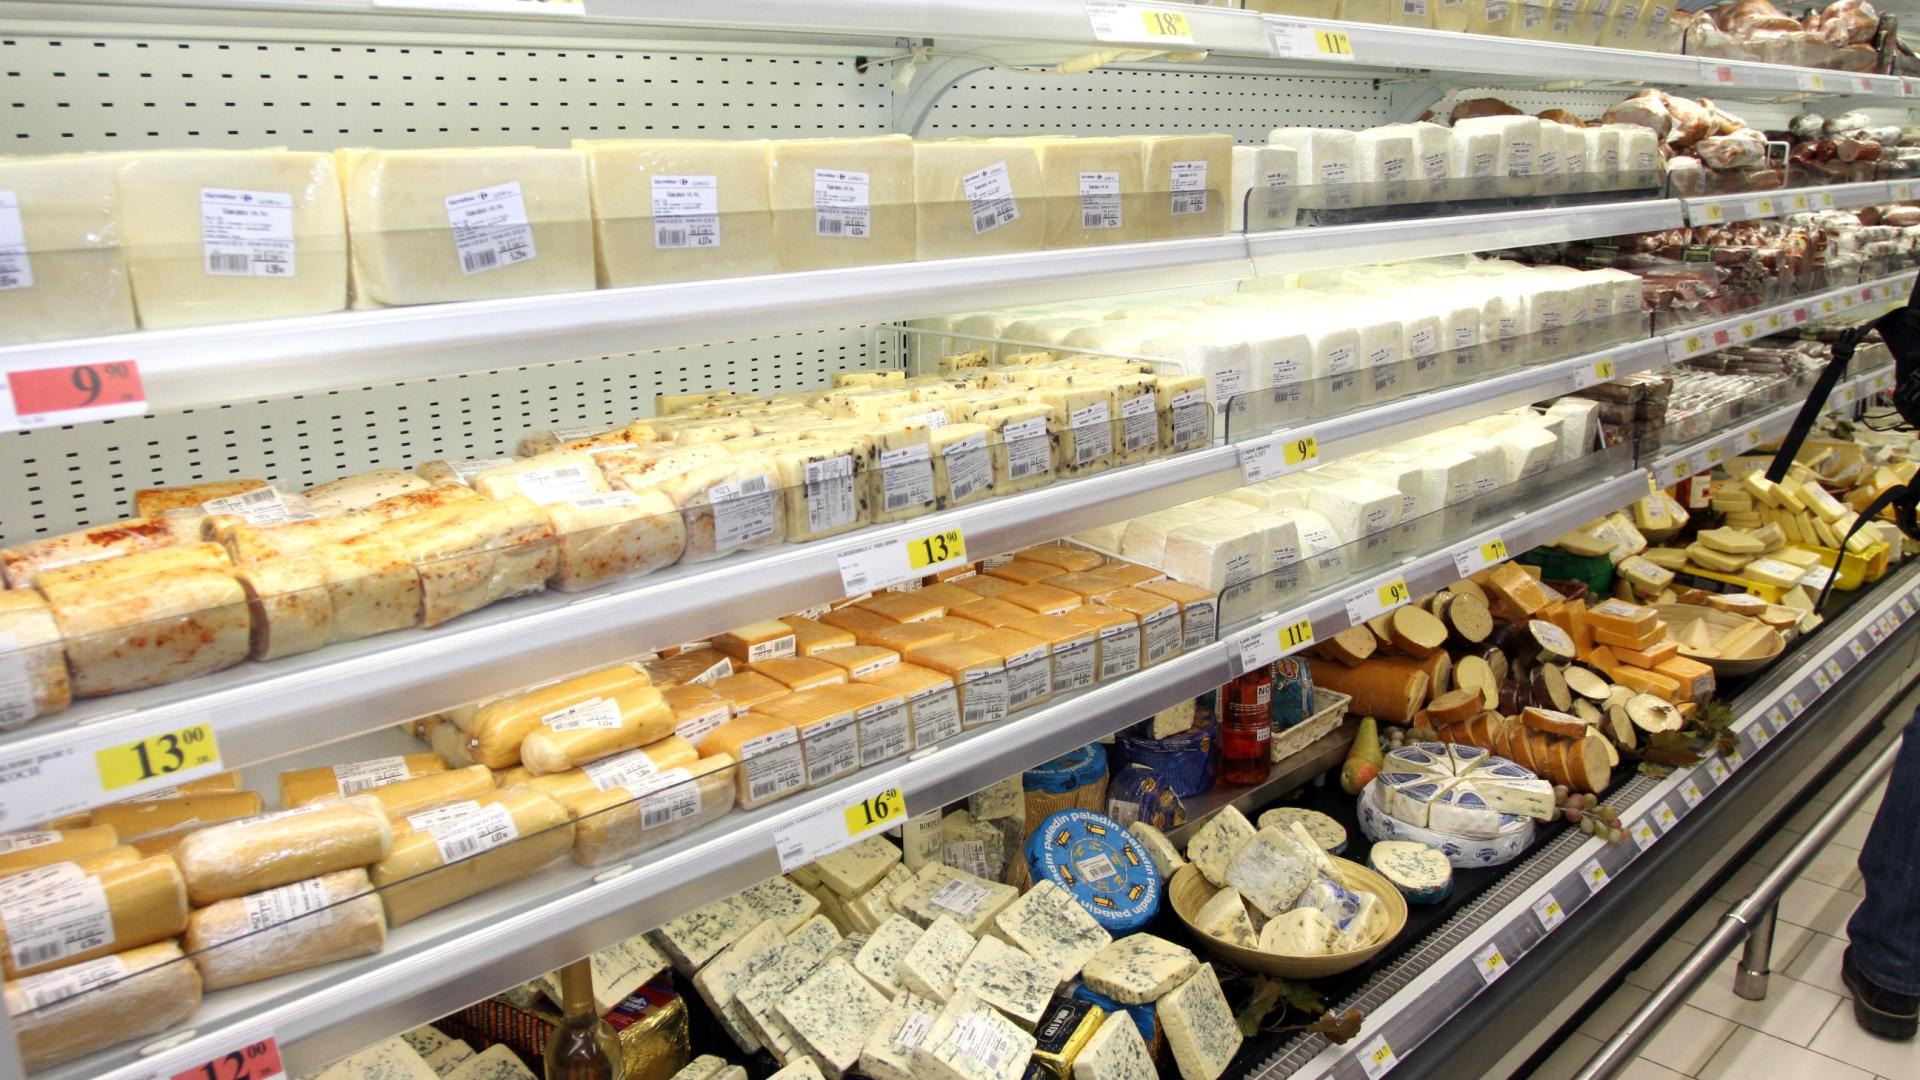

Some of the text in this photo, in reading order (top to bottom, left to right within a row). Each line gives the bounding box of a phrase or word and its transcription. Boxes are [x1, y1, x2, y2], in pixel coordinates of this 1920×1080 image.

[1153, 13, 1174, 36] 18
[1324, 31, 1341, 54] 11
[72, 365, 101, 407] 9
[923, 534, 949, 565] 13
[946, 531, 958, 543] 90
[1288, 624, 1304, 646] 11
[131, 727, 204, 781] 13 00
[861, 791, 889, 826] 16
[1071, 811, 1120, 831] paladin
[1044, 815, 1070, 851] paladin
[1120, 830, 1154, 876] paladin
[1080, 899, 1132, 919] paladin
[1131, 877, 1156, 916] paladin
[200, 1050, 250, 1080] 12
